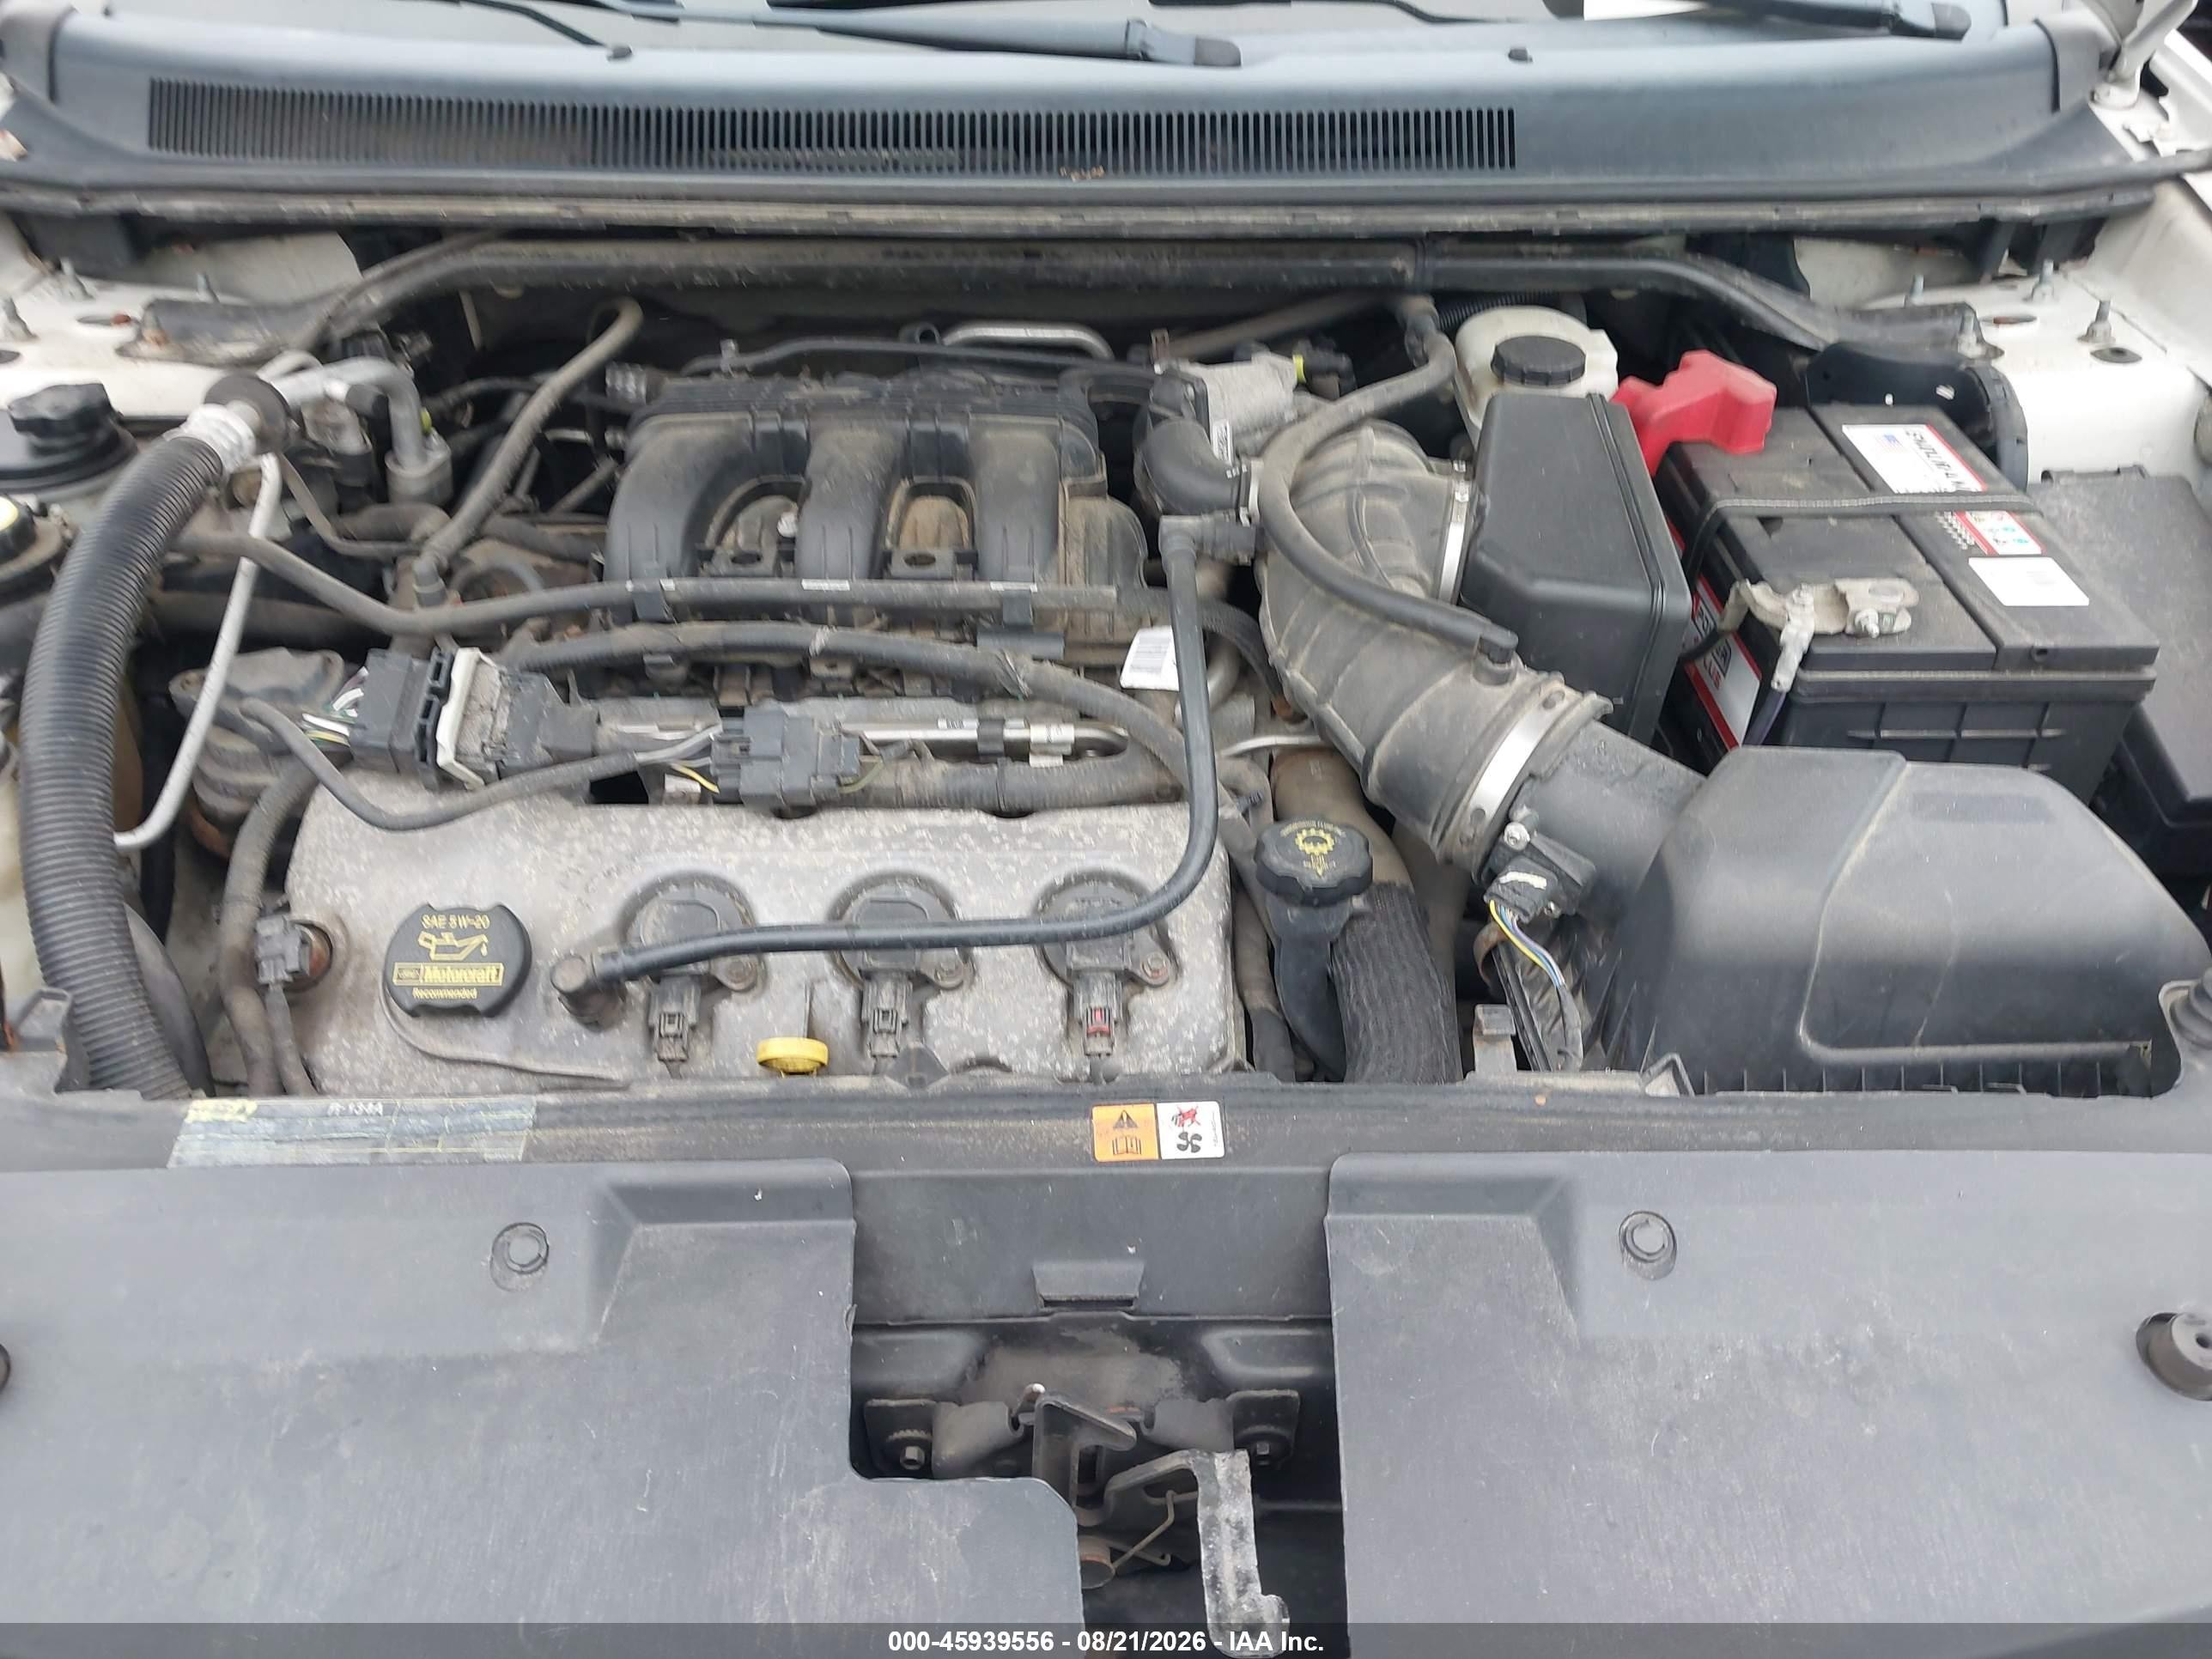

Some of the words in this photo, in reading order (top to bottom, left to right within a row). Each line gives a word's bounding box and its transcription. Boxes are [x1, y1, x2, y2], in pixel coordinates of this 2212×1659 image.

[421, 914, 447, 929] SAE
[448, 914, 490, 930] 5W-20
[423, 965, 499, 983] Motorcraft
